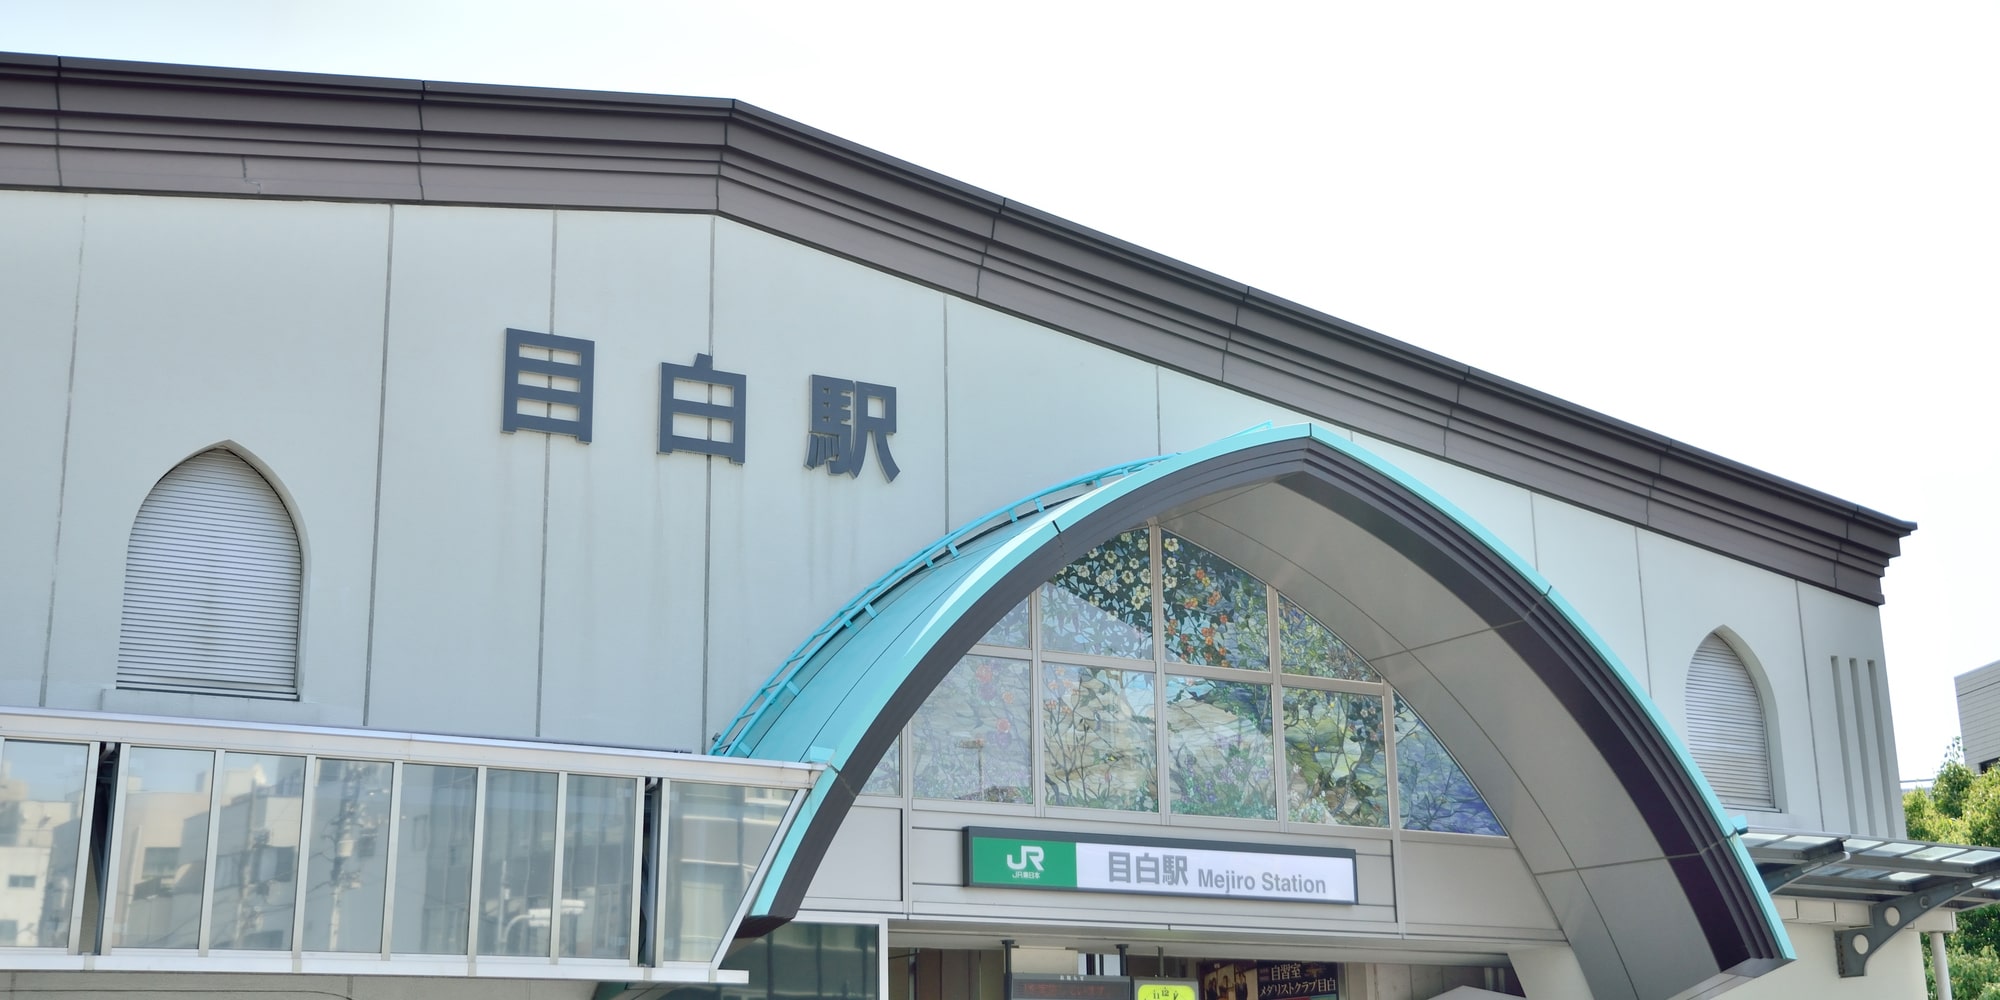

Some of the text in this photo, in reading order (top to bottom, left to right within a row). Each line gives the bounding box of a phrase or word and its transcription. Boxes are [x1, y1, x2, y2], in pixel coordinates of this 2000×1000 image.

[500, 328, 900, 483] 目白駅
[1007, 845, 1044, 871] JR
[1108, 851, 1326, 894] 目白駅 Mejiro Station
[1271, 963, 1302, 980] 自習室
